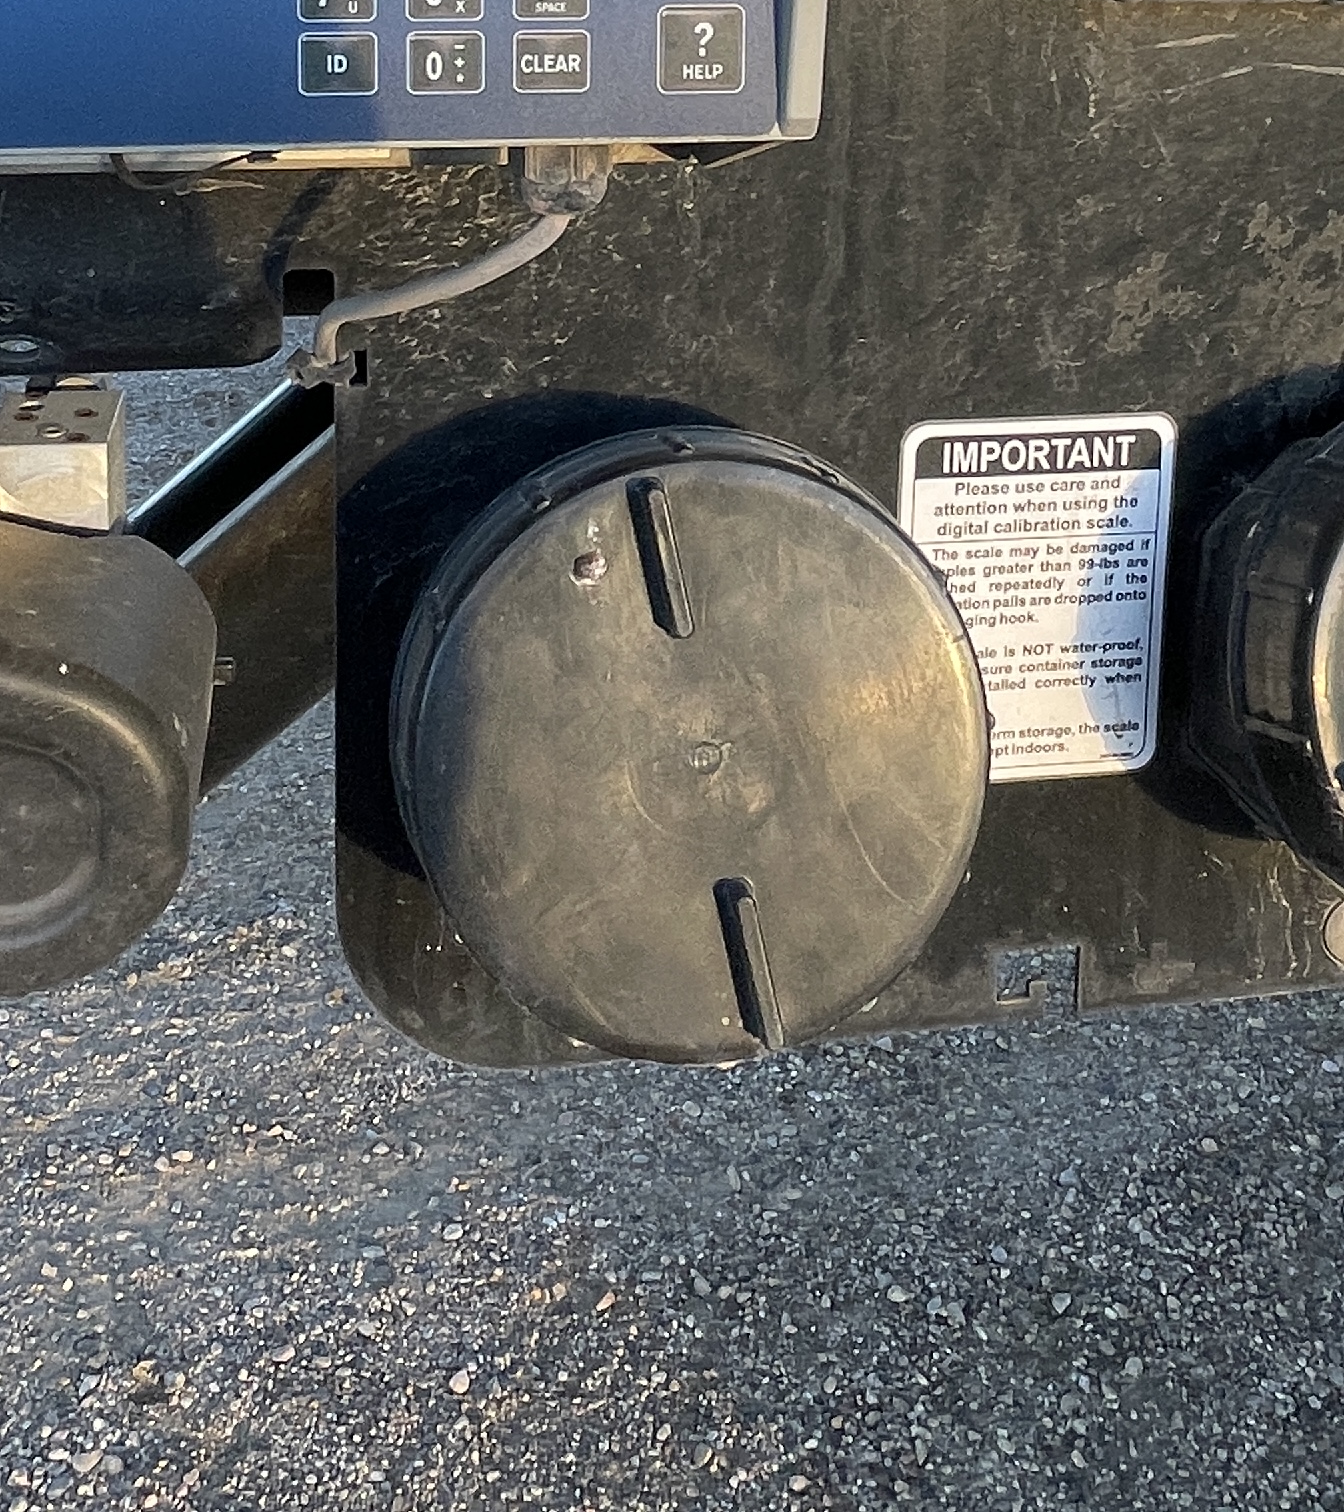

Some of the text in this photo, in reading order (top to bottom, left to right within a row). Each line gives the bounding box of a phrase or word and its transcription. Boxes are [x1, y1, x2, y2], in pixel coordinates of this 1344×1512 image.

[694, 22, 715, 58] ?
[326, 54, 348, 74] ID
[426, 52, 443, 80] 0
[521, 54, 581, 73] CLEAR
[682, 63, 724, 80] HELP
[942, 435, 1137, 474] IMPORTANT
[954, 476, 1121, 497] Please use care and
[934, 495, 1138, 517] attention when using the
[937, 514, 1132, 539] digital calibration scale.
[932, 538, 1150, 562] The scale may be damaged if
[1022, 639, 1144, 656] NOT water-proof,
